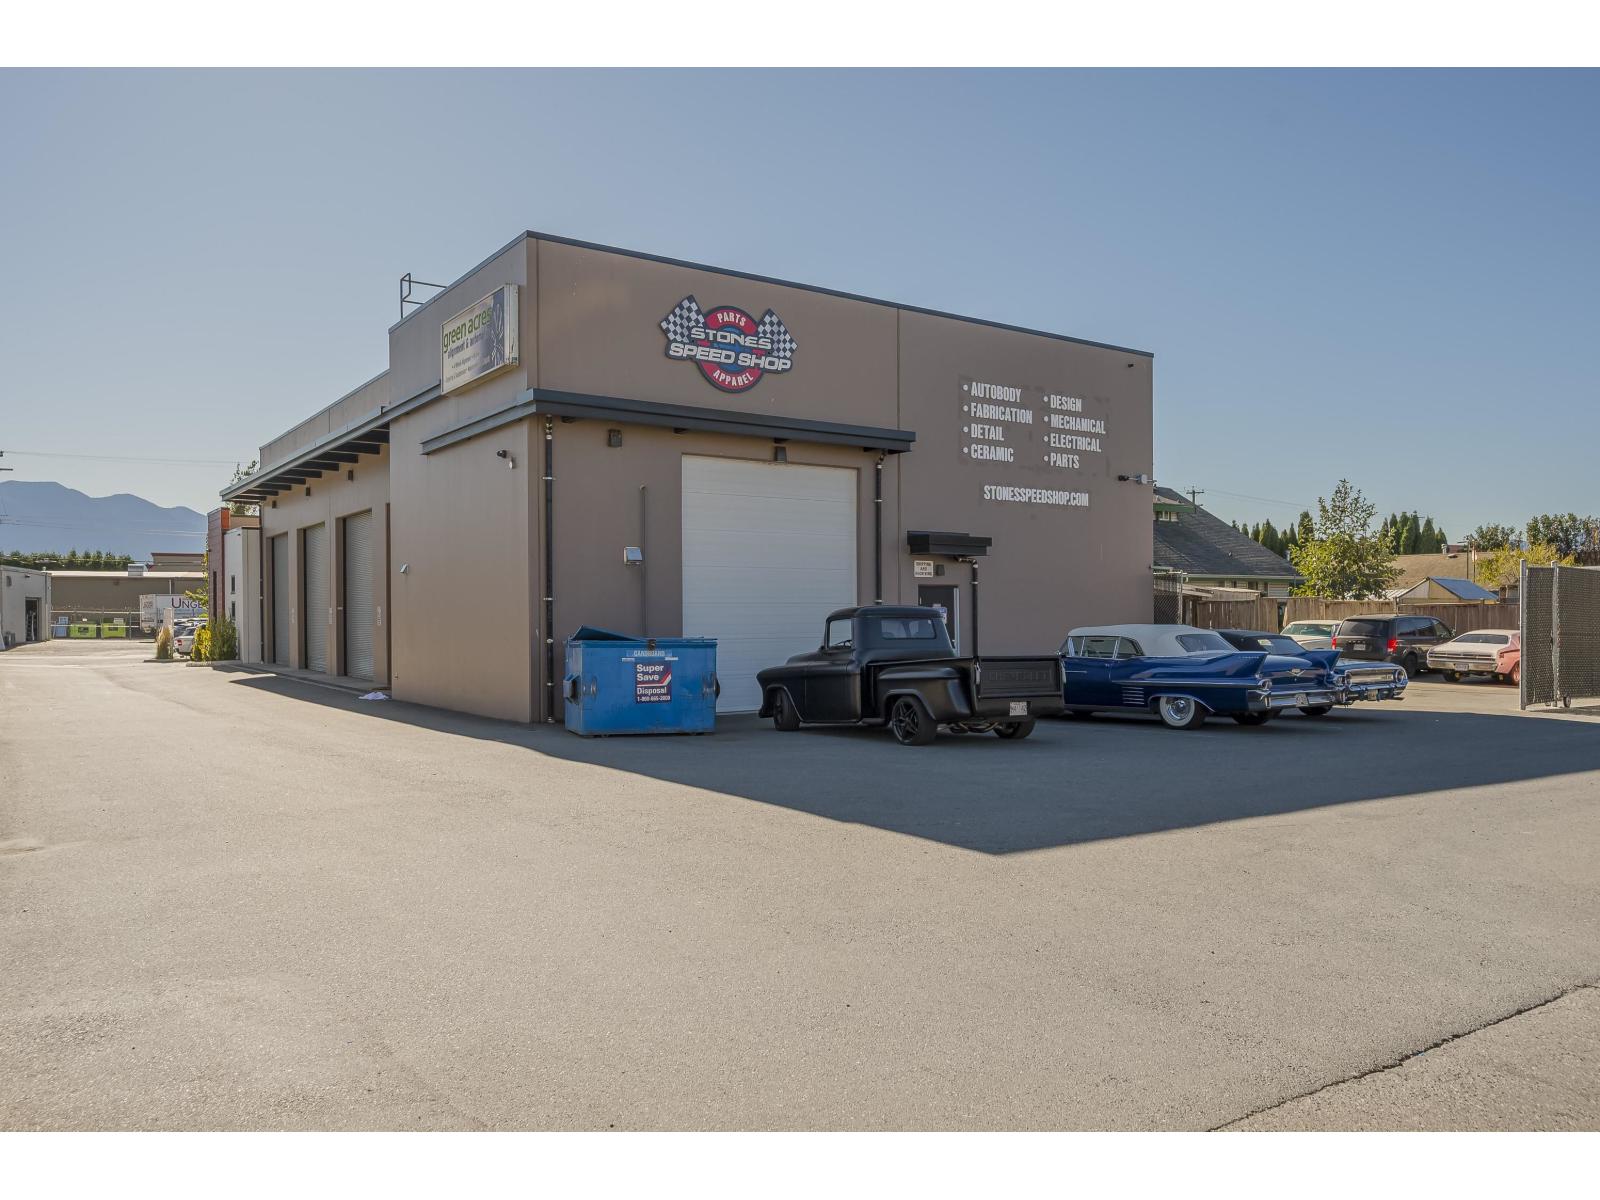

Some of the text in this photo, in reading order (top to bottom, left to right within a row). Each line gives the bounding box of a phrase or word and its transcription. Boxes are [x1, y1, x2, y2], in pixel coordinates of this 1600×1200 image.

[716, 311, 746, 327] PARTS
[443, 322, 467, 353] green
[467, 306, 492, 333] acres
[690, 327, 772, 350] STONES
[669, 342, 792, 371] SPEED SHOP
[712, 369, 754, 387] APPAREL
[970, 381, 1022, 403] AUTOBODY
[970, 402, 1033, 424] FABRICATION
[1050, 394, 1082, 413] DESIGN
[970, 423, 1005, 441] DETAIL
[1050, 413, 1106, 434] MECHANICAL
[1050, 432, 1102, 453] ELECTRICAL
[970, 443, 1014, 462] CERAMIC
[1050, 452, 1080, 469] PARTS
[983, 484, 1089, 507] STONESSPEEDSHOP.COM
[636, 664, 664, 674] Super
[636, 673, 660, 681] Save
[636, 687, 667, 695] Disposal
